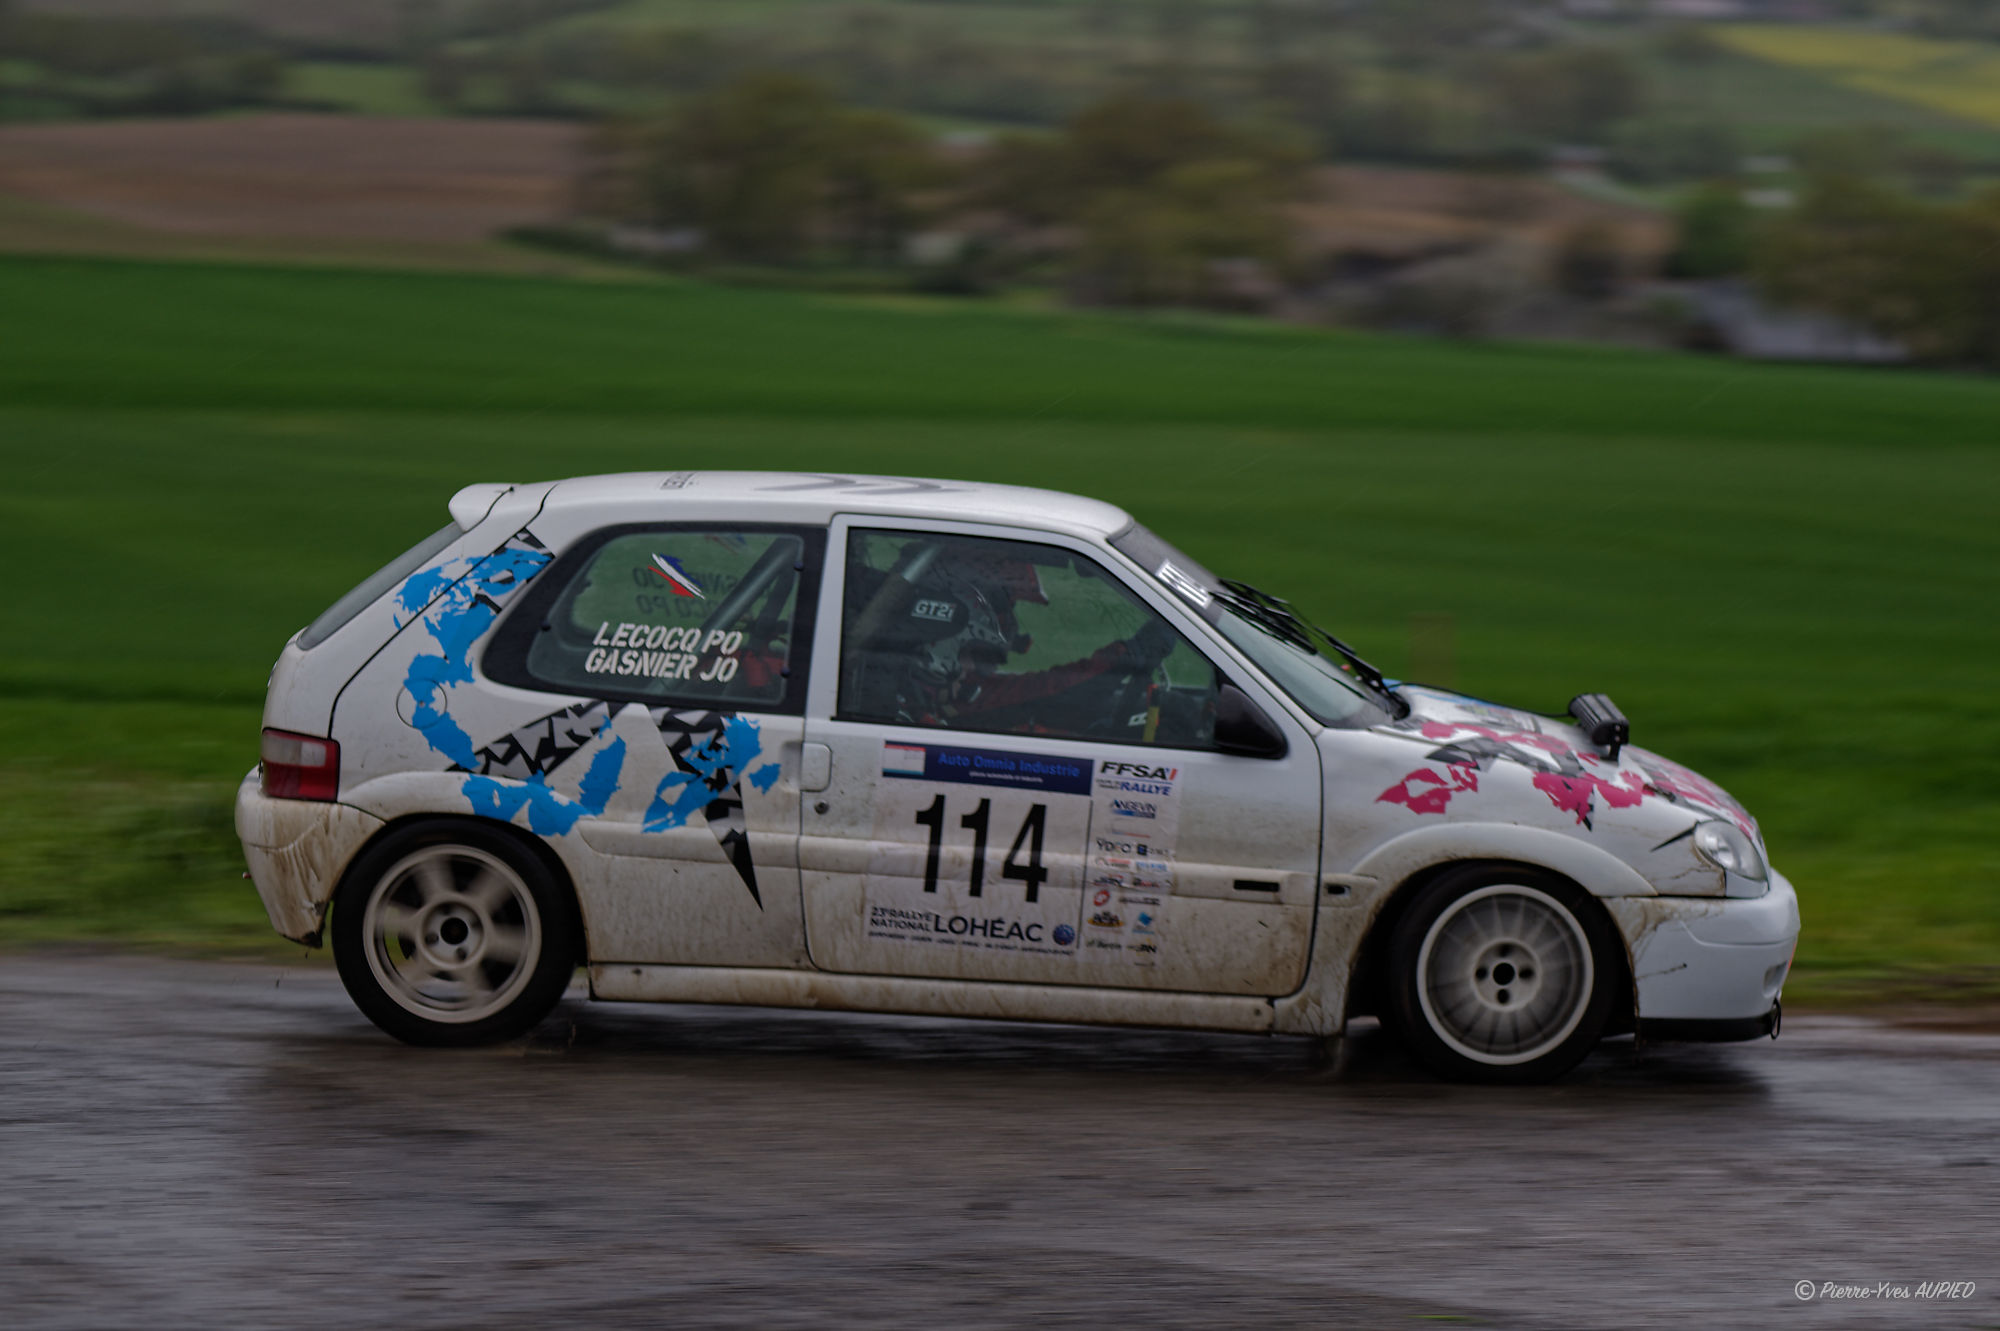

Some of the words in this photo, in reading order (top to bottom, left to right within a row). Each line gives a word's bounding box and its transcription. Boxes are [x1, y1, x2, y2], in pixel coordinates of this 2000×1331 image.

[593, 621, 701, 653] LECOCQ
[701, 629, 743, 655] PO
[585, 648, 698, 680] GASNIER
[700, 656, 739, 683] JO
[937, 753, 970, 767] Auto
[973, 755, 1017, 771] Omnia
[1020, 760, 1081, 777] Industrie
[1101, 761, 1168, 780] FFSA
[1121, 782, 1171, 796] RALLYE
[915, 794, 1048, 903] 114
[870, 918, 931, 932] NATIONAL
[934, 914, 1043, 942] LOHÉAC
